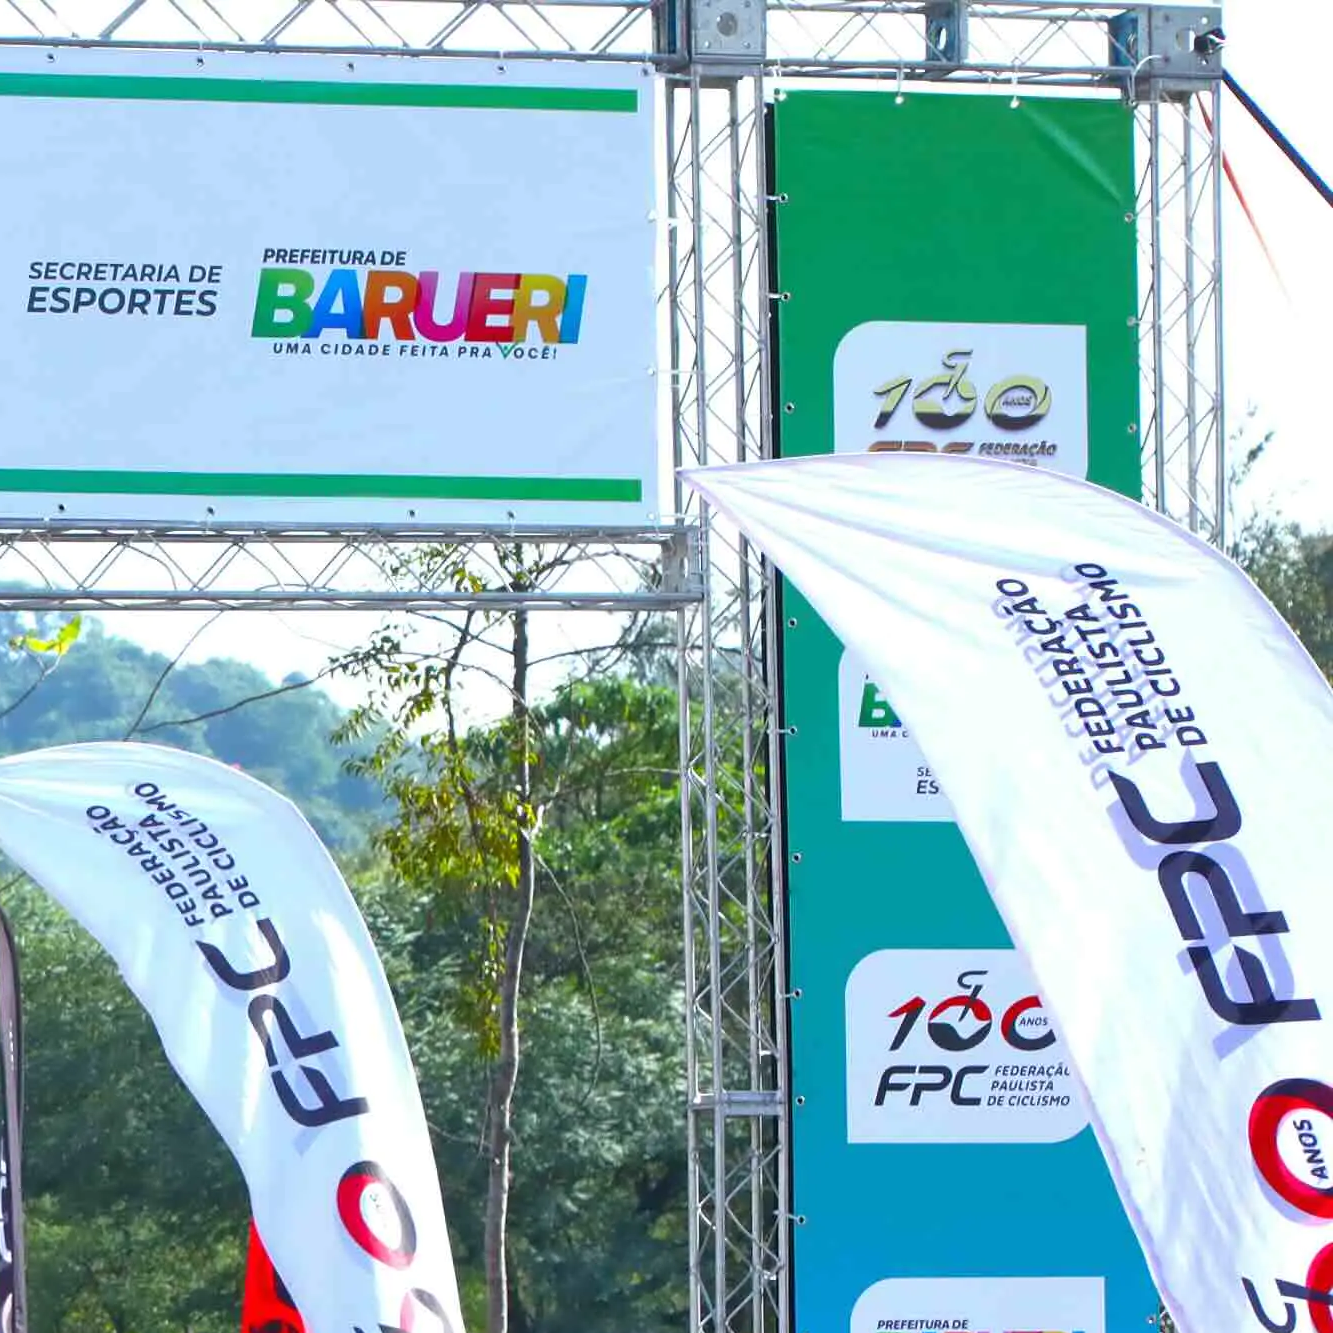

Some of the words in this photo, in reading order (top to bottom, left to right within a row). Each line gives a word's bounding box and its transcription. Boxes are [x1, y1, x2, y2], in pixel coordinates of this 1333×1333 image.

[28, 261, 181, 283] SECRETARIA
[187, 264, 222, 284] DE
[262, 248, 376, 265] PREFEITURA
[380, 250, 407, 266] DE
[26, 286, 218, 318] ESPORTES
[251, 269, 588, 345] BARUERI
[273, 342, 313, 356] UMA
[320, 343, 391, 358] CIDADE
[398, 345, 450, 359] FEITA
[457, 346, 494, 360] PRA
[874, 366, 1052, 431] 100
[978, 440, 1058, 457] FEDERAÇÃO
[1073, 562, 1182, 697] CICLISMO
[995, 577, 1126, 754] FEDERAÇÃO
[1064, 603, 1167, 752] PAULISTA
[871, 730, 898, 738] UMA
[1163, 704, 1209, 747] DE
[134, 781, 236, 870] CICLISMO
[85, 804, 206, 928] FEDERAÇÃO
[138, 813, 234, 920] PAULISTA
[227, 875, 261, 910] DE
[1106, 760, 1322, 1027] FPC
[194, 917, 371, 1128] FPC
[1019, 1016, 1049, 1027] ANOS
[874, 1064, 990, 1107] FPC
[986, 1095, 1004, 1107] DE
[1008, 1095, 1071, 1107] CICLISMO
[990, 1080, 1055, 1092] PAULISTA
[1293, 1118, 1329, 1180] ANOS
[877, 1319, 950, 1330] PREFEITURA
[951, 1319, 968, 1330] DE
